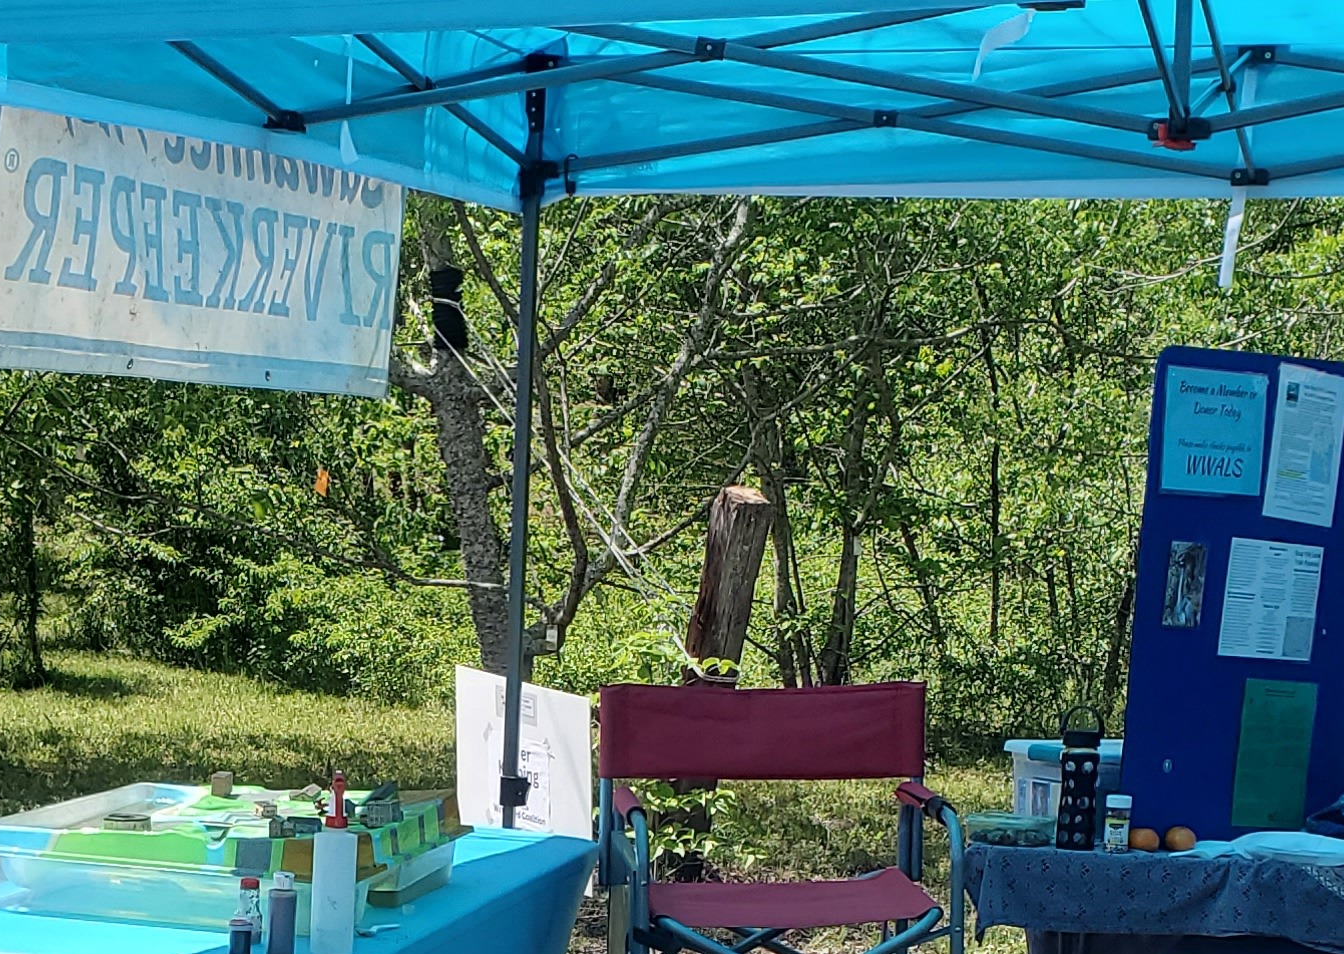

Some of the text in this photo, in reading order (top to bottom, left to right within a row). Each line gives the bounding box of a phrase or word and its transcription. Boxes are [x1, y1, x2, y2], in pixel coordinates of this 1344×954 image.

[1220, 403, 1242, 422] Today
[1186, 454, 1244, 478] WWALS
[522, 811, 547, 826] Coalition
